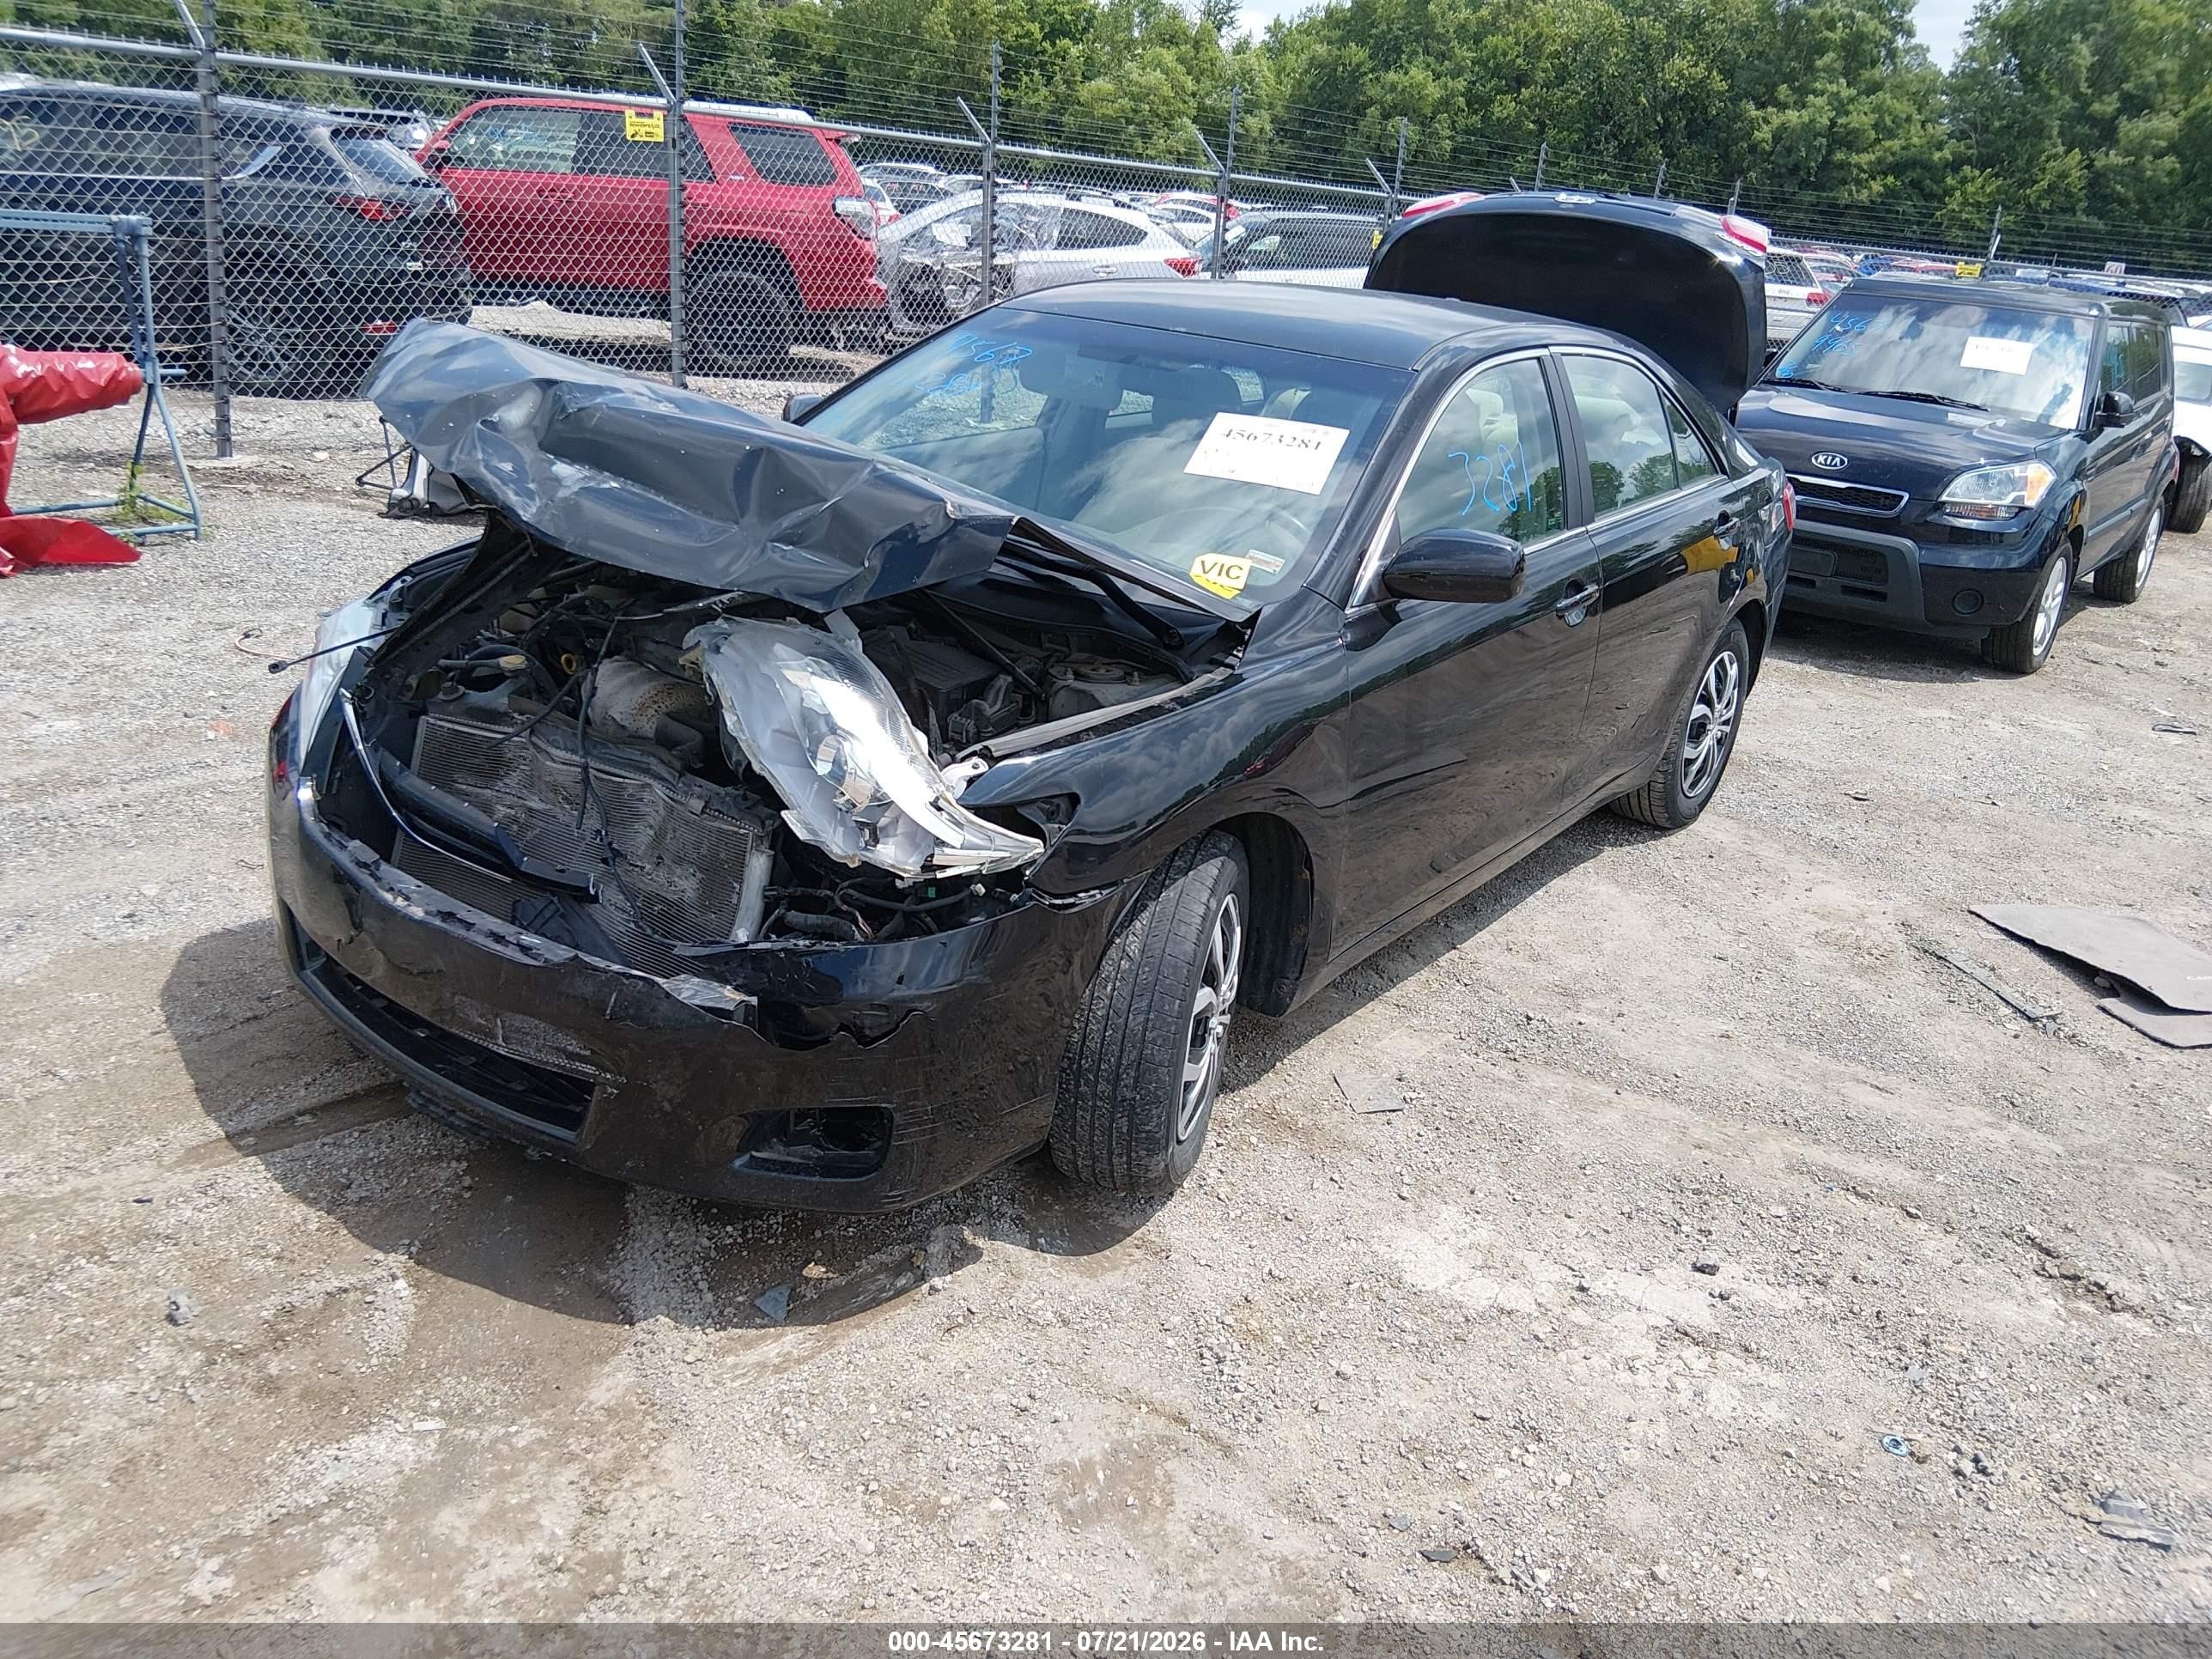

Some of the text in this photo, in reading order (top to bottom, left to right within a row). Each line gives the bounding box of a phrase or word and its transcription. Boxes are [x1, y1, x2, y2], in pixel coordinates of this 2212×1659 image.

[1223, 428, 1322, 451] 45673281
[1817, 454, 1841, 467] KIA
[1448, 441, 1531, 516] 3281
[1200, 560, 1243, 580] VIC
